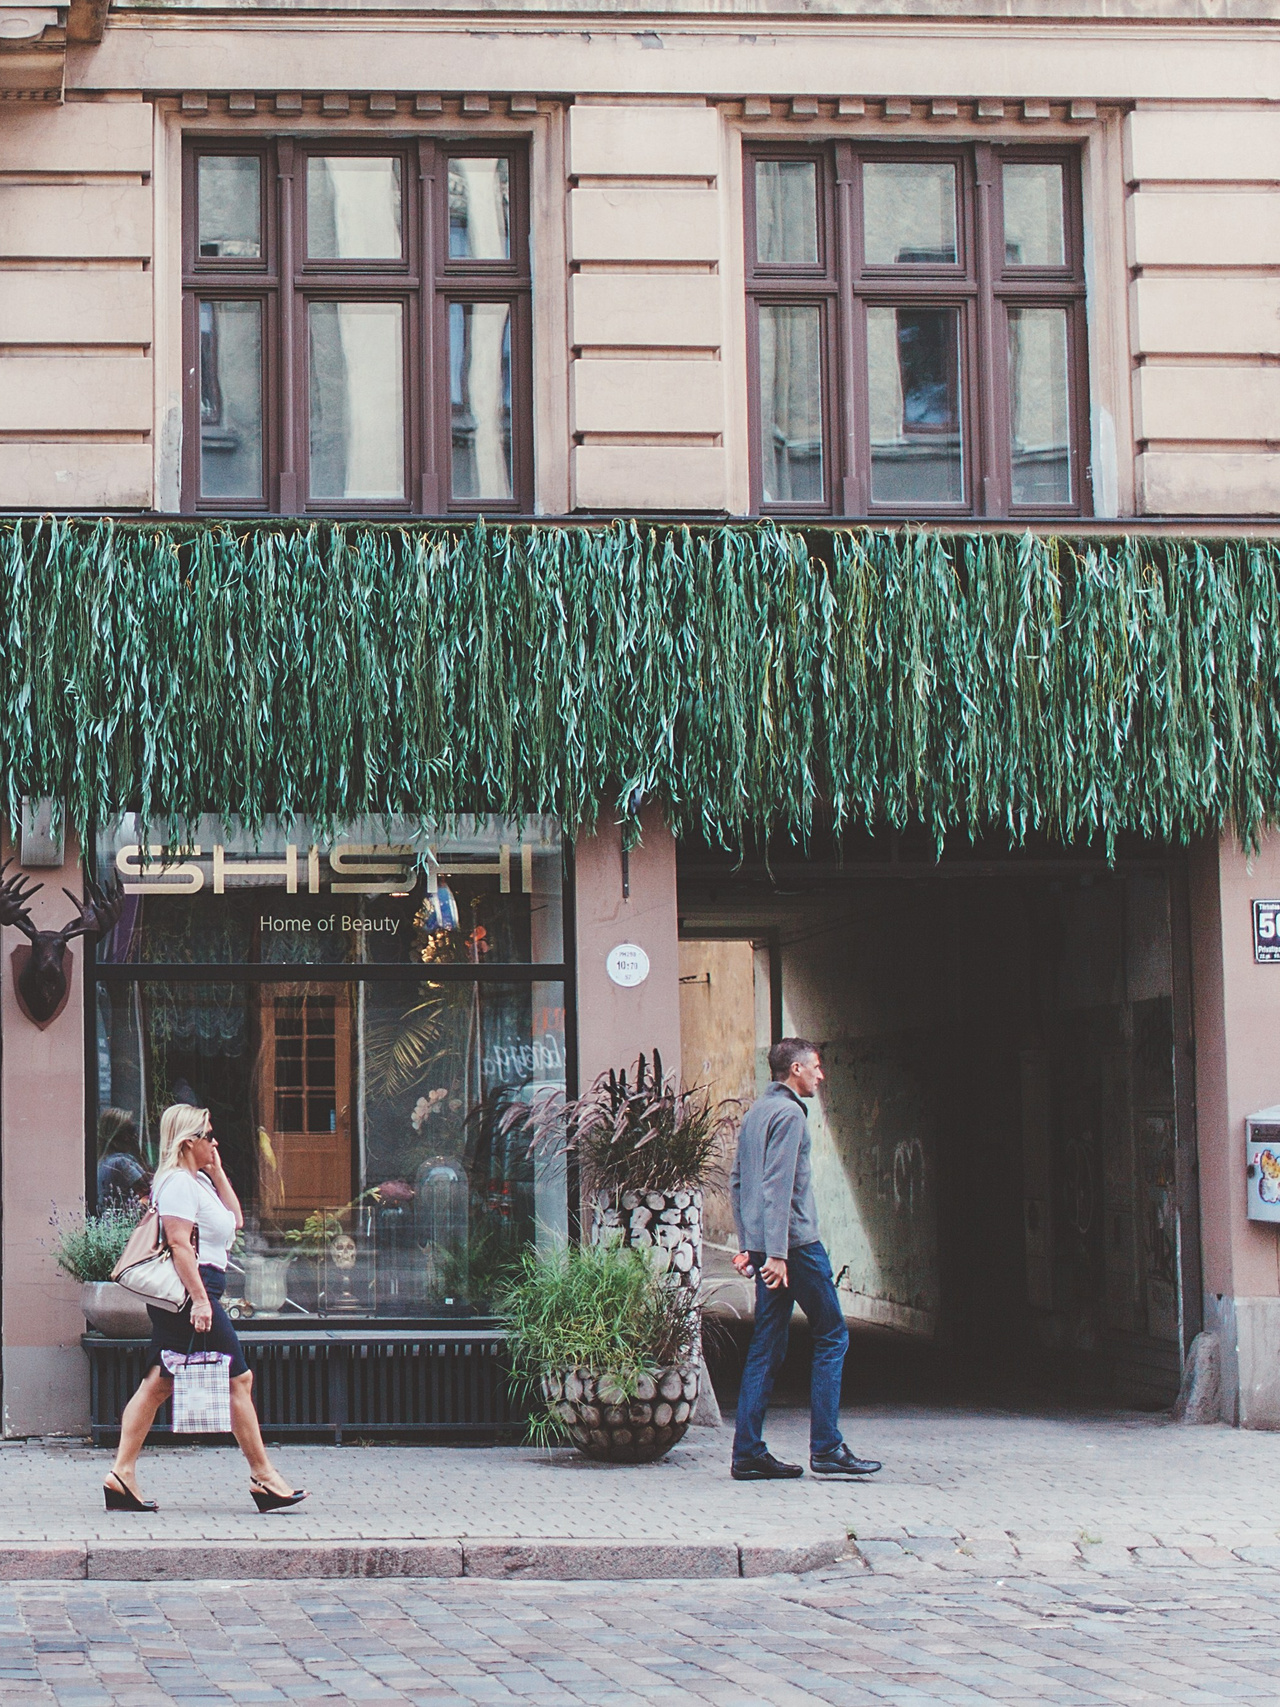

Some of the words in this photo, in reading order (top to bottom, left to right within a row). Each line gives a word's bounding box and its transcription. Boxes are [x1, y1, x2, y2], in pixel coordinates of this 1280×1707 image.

[115, 843, 533, 895] SHISHI
[260, 915, 311, 932] Home
[318, 914, 336, 932] of
[342, 915, 400, 936] Beauty
